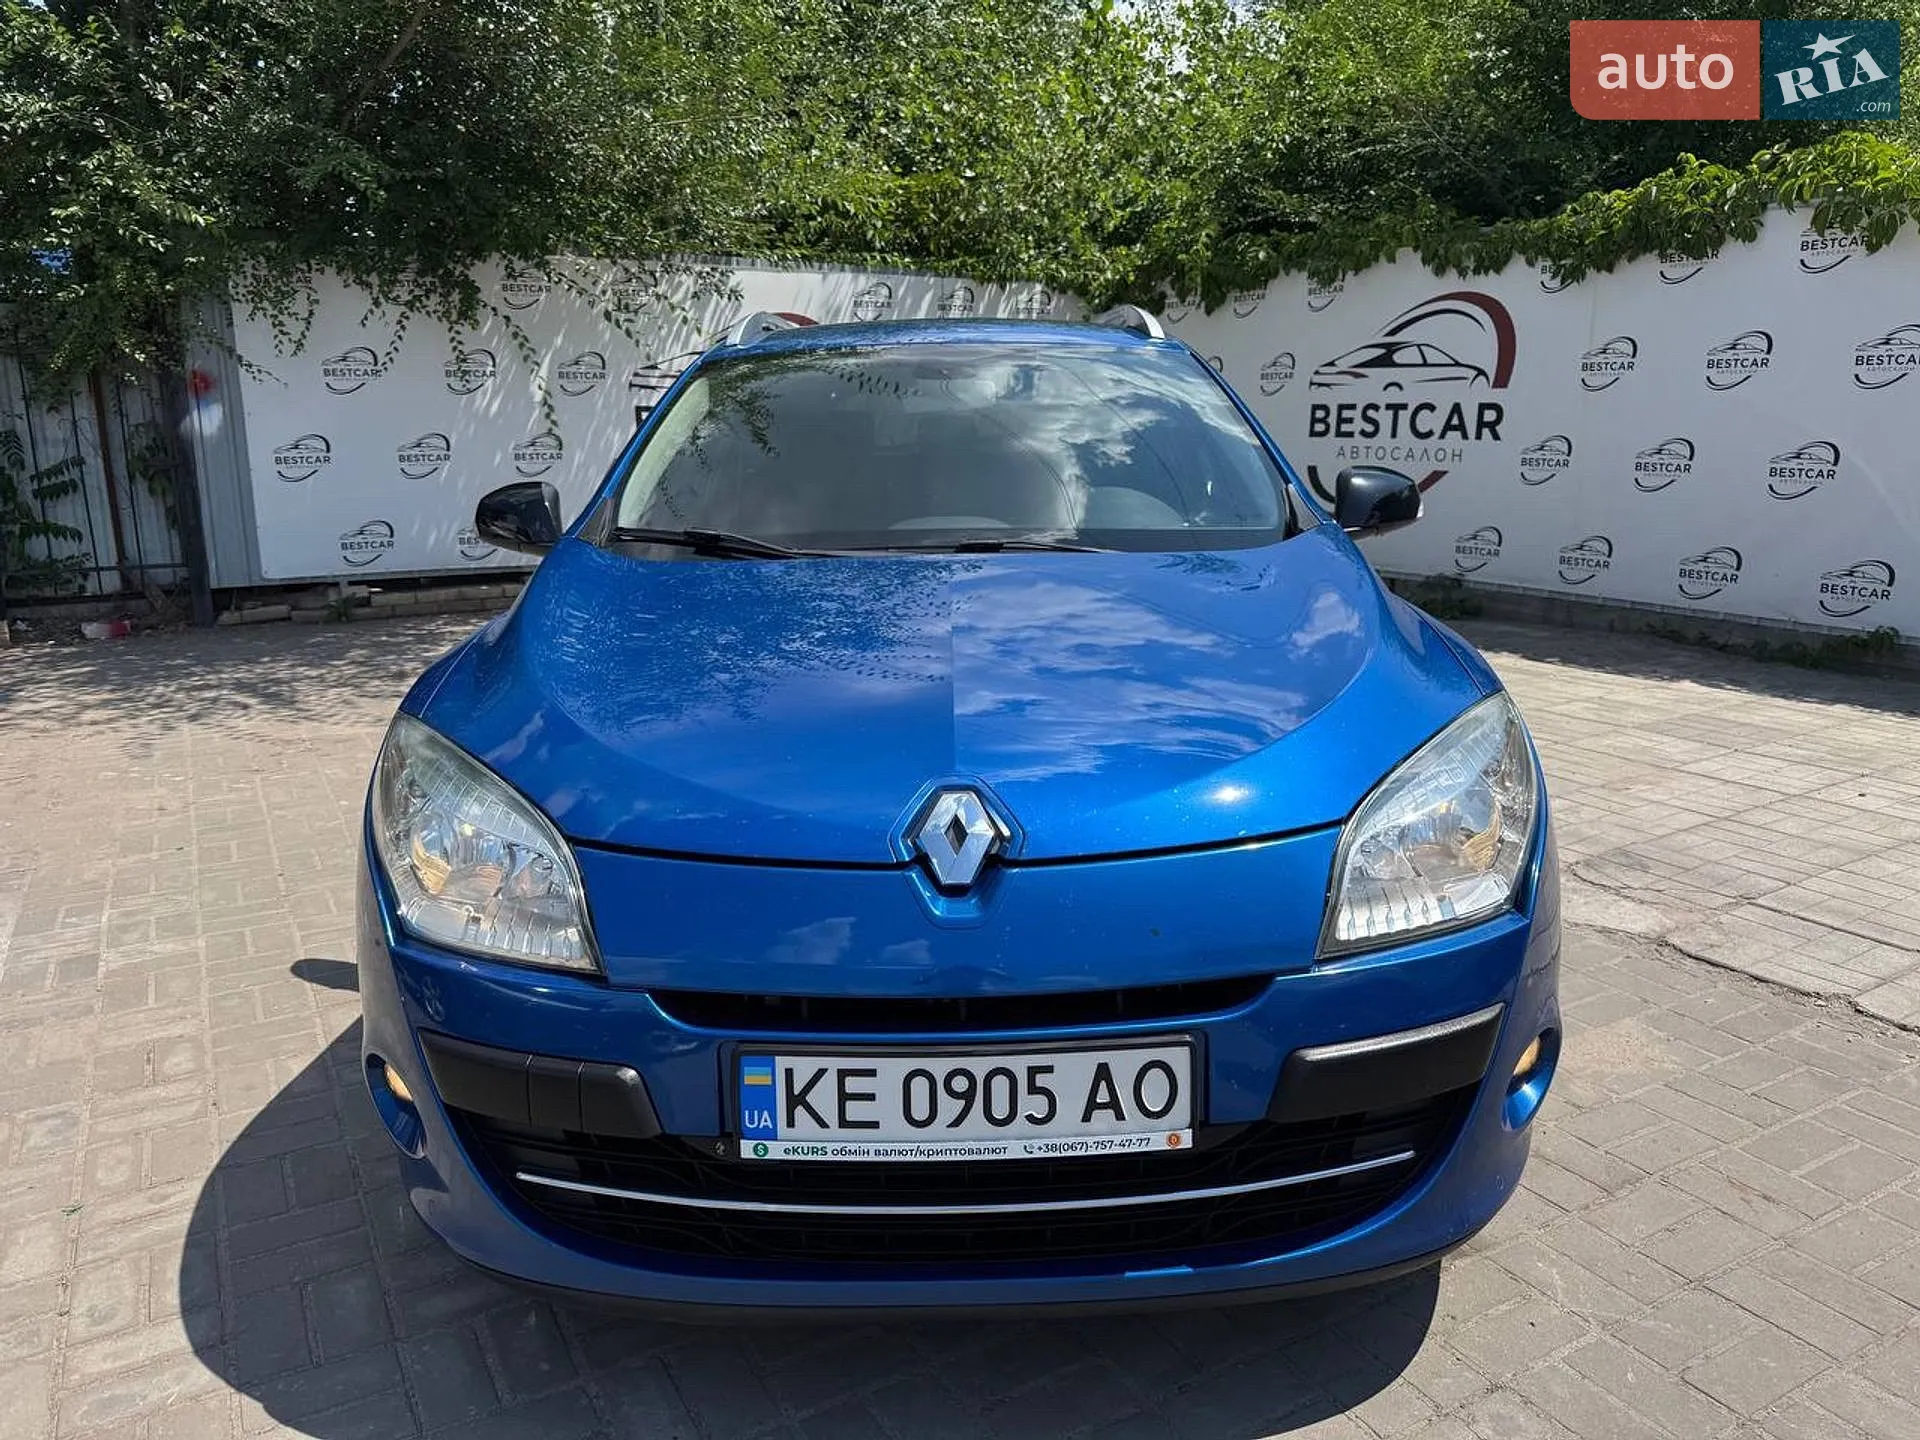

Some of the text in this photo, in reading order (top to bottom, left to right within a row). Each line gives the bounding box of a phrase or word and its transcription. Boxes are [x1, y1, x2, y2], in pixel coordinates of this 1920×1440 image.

[1706, 357, 1769, 369] BESTCAR
[1855, 353, 1920, 366] BESTCA
[1581, 361, 1635, 372] BESTCAR
[558, 370, 606, 380] BESTCAR
[1309, 402, 1504, 441] BESTCAR
[274, 455, 331, 465] BESTCAR
[399, 453, 451, 463] BESTCAR
[514, 452, 563, 462] BESTCAR
[1336, 446, 1463, 464] АВТОСАЛОН
[1520, 457, 1570, 469] BESTCAR
[1634, 461, 1692, 473] BESTCAR
[1769, 466, 1836, 480] BESTCAR
[341, 540, 394, 551] BESTCAR
[1455, 545, 1500, 557] BESTCAR
[1560, 555, 1610, 569] BESTCAR
[1679, 568, 1739, 584] BESTCAR
[1820, 583, 1891, 601] BESTCAR
[784, 1059, 1179, 1129] KE 0905 AO
[744, 1110, 773, 1129] UA
[783, 1145, 828, 1157] eKURS
[831, 1144, 870, 1157] обмін
